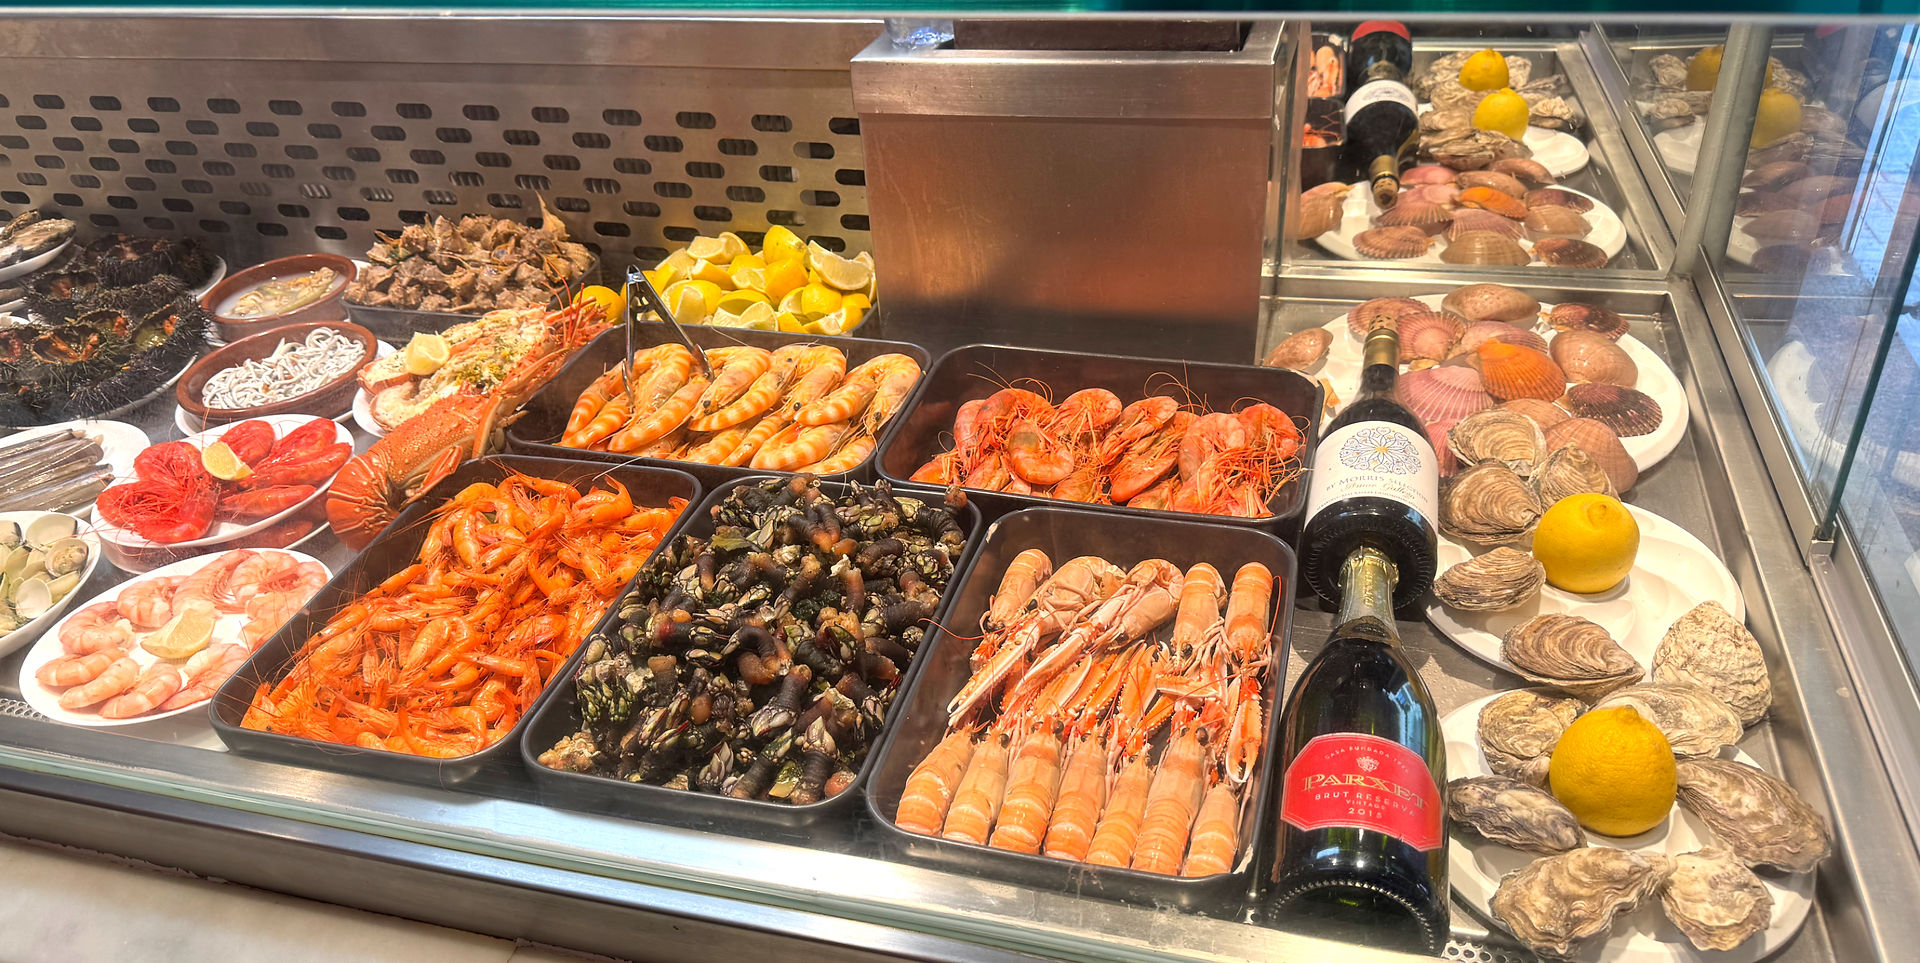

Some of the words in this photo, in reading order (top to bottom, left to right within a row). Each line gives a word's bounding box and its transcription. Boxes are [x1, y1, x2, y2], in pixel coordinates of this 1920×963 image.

[1339, 475, 1384, 485] MORRIS
[1325, 748, 1345, 760] CASA
[1301, 773, 1430, 810] PARXET
[1315, 791, 1349, 801] BRUT
[1345, 799, 1386, 810] VINTAGE
[1348, 807, 1382, 819] 2015
